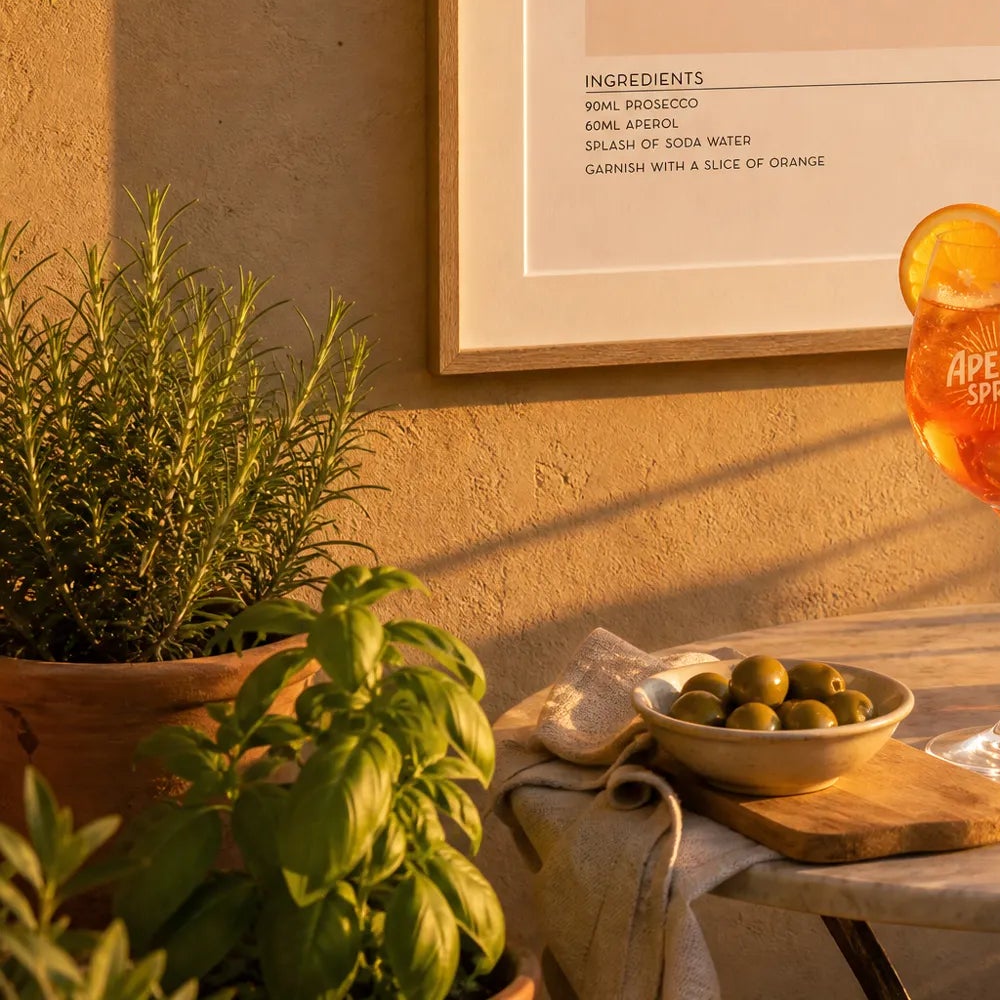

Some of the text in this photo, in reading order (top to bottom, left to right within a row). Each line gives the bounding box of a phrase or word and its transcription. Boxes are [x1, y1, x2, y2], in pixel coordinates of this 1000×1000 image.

[585, 71, 704, 88] INGREDIENTS
[585, 98, 699, 112] 90ML PROSECCO
[585, 118, 679, 132] 60ML APEROL
[585, 135, 752, 152] SPLASH OF SODA WATER
[585, 156, 825, 175] GARNISH WITH A SLICE OF ORANGE
